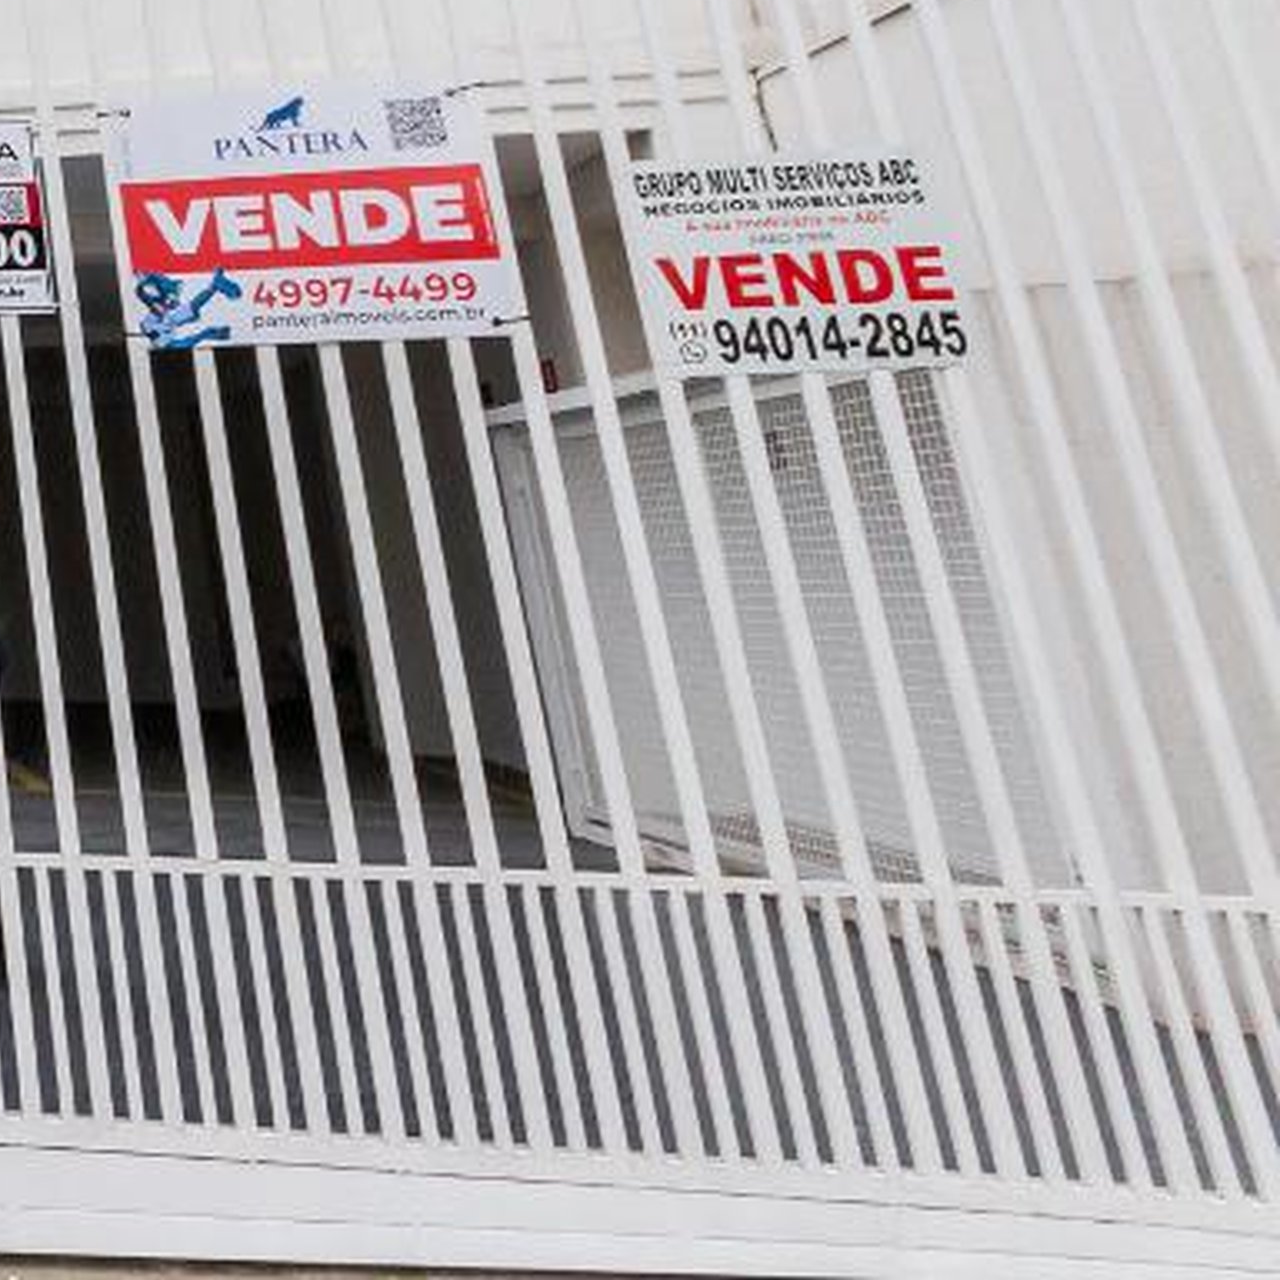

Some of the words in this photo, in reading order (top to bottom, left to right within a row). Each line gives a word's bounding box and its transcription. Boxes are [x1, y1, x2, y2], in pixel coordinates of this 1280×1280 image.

[214, 130, 369, 160] PANTERA
[633, 171, 702, 199] GRUPO
[706, 166, 768, 195] MULTI
[879, 159, 919, 187] ABC
[145, 183, 475, 255] VENDE
[252, 272, 478, 309] 4997-4499
[654, 246, 955, 311] VENDE
[713, 310, 968, 364] 94014-2845
